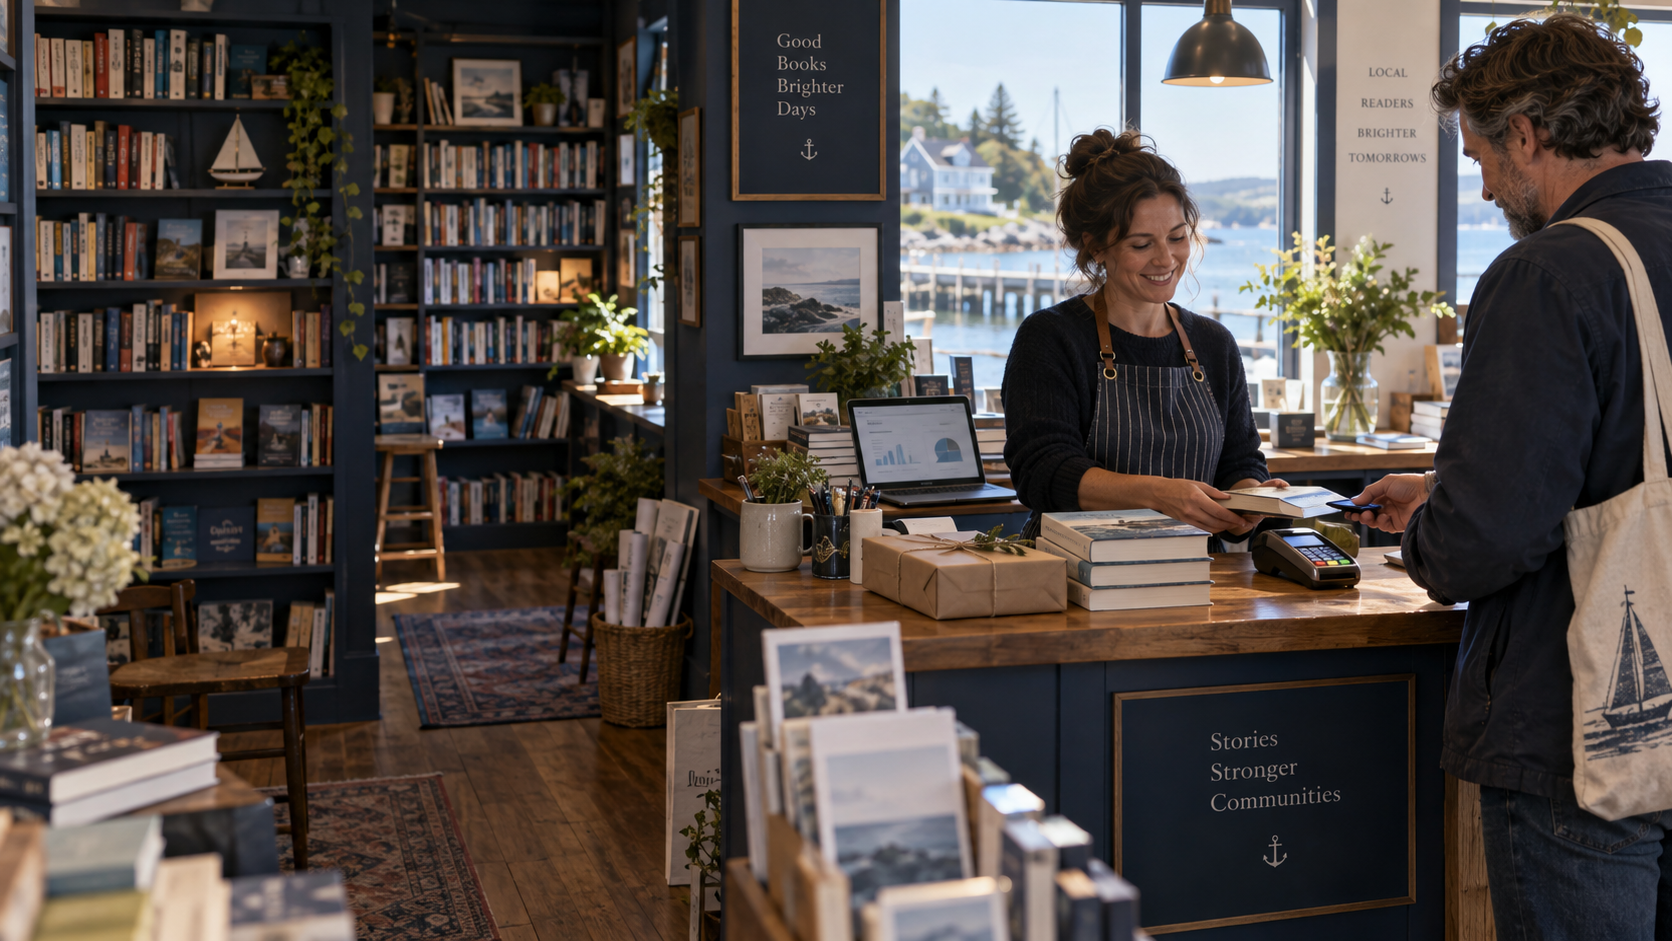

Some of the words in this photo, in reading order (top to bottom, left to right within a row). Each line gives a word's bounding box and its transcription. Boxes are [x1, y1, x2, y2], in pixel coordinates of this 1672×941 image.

[777, 33, 822, 49] Good
[777, 55, 827, 71] Books
[1368, 67, 1408, 78] LOCAL
[777, 77, 845, 98] Brighter
[777, 100, 816, 120] Days
[1361, 97, 1415, 109] READERS
[1357, 127, 1417, 138] BRIGHTER
[1348, 152, 1427, 163] TOMORROWS
[1210, 729, 1278, 751] Stories
[1210, 762, 1298, 783] Stronger
[1210, 785, 1341, 812] Communities
